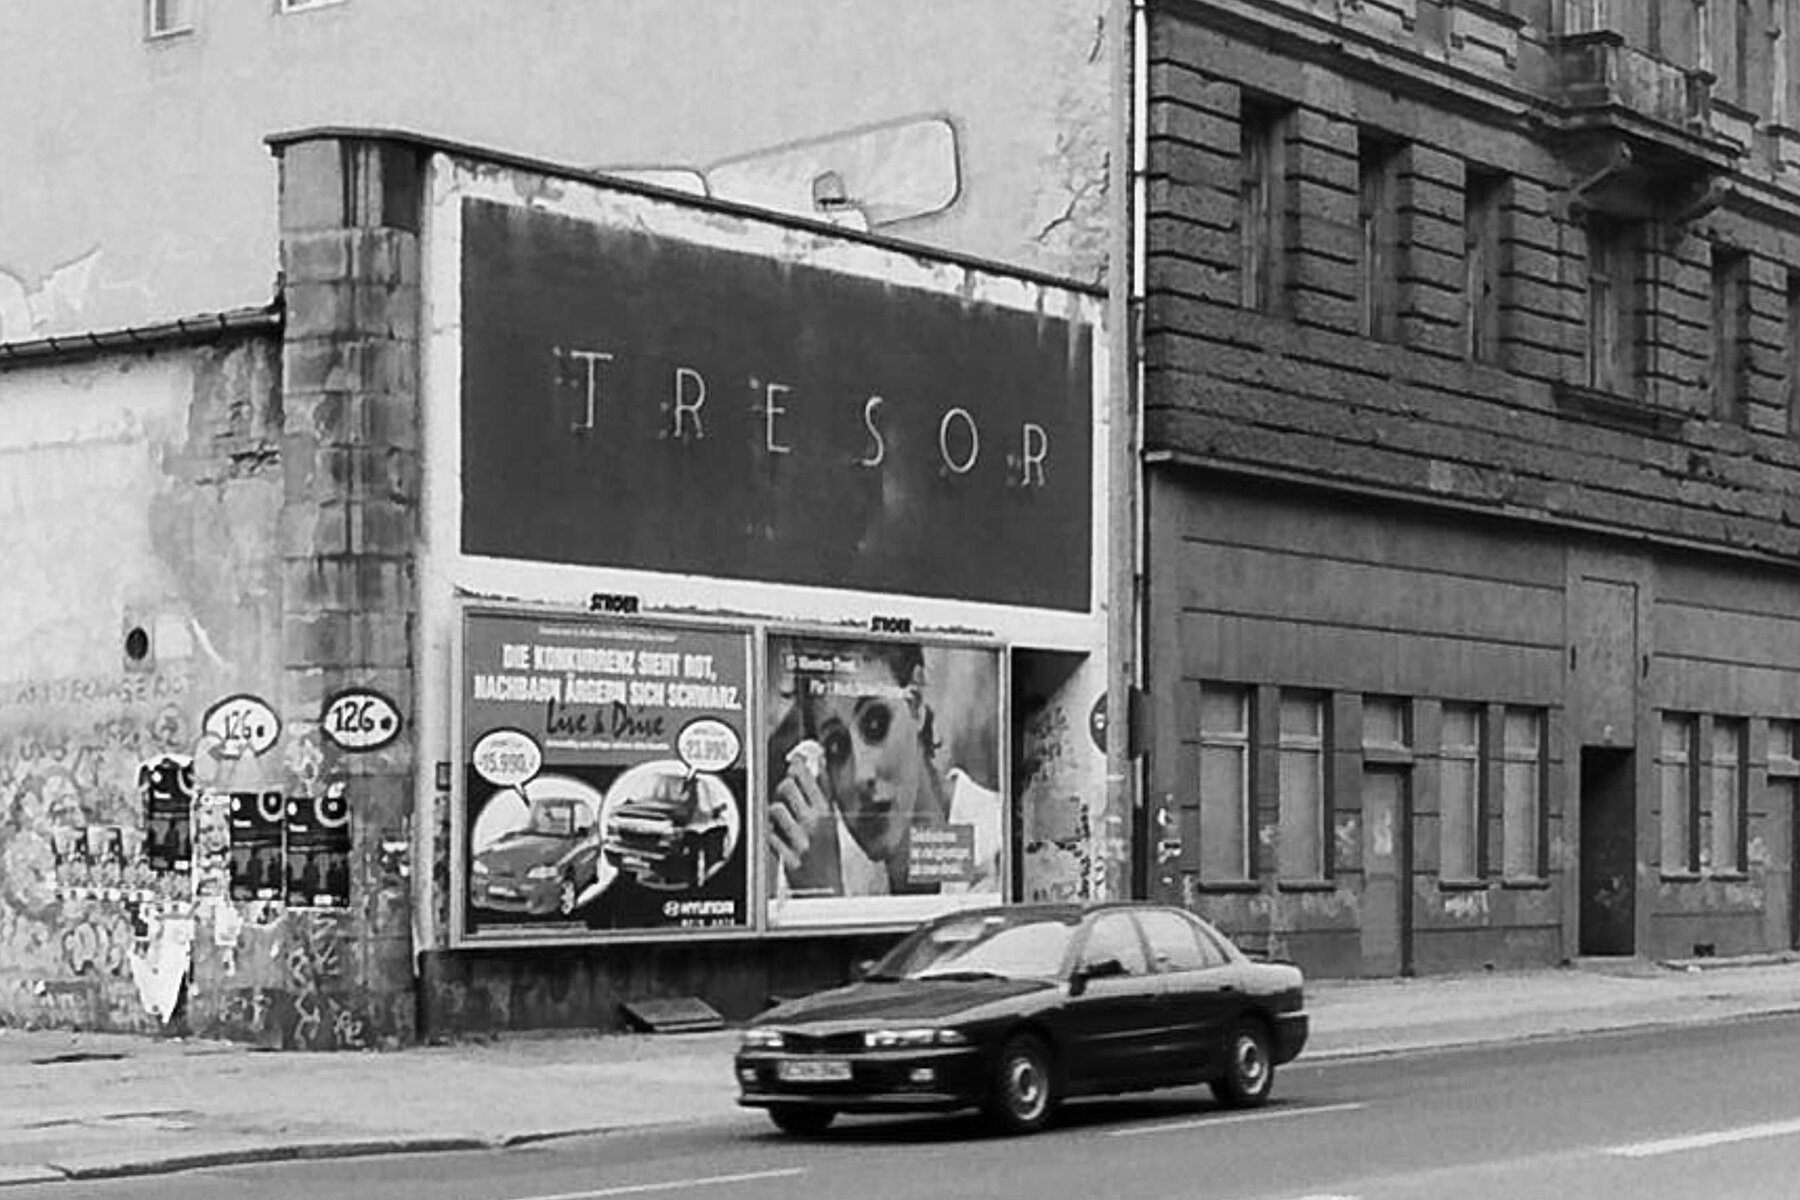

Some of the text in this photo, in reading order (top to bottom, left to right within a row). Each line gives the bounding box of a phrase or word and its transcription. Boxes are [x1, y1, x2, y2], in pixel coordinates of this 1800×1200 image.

[569, 350, 1048, 486] TRESOR
[224, 710, 252, 740] 126
[333, 701, 375, 733] 126
